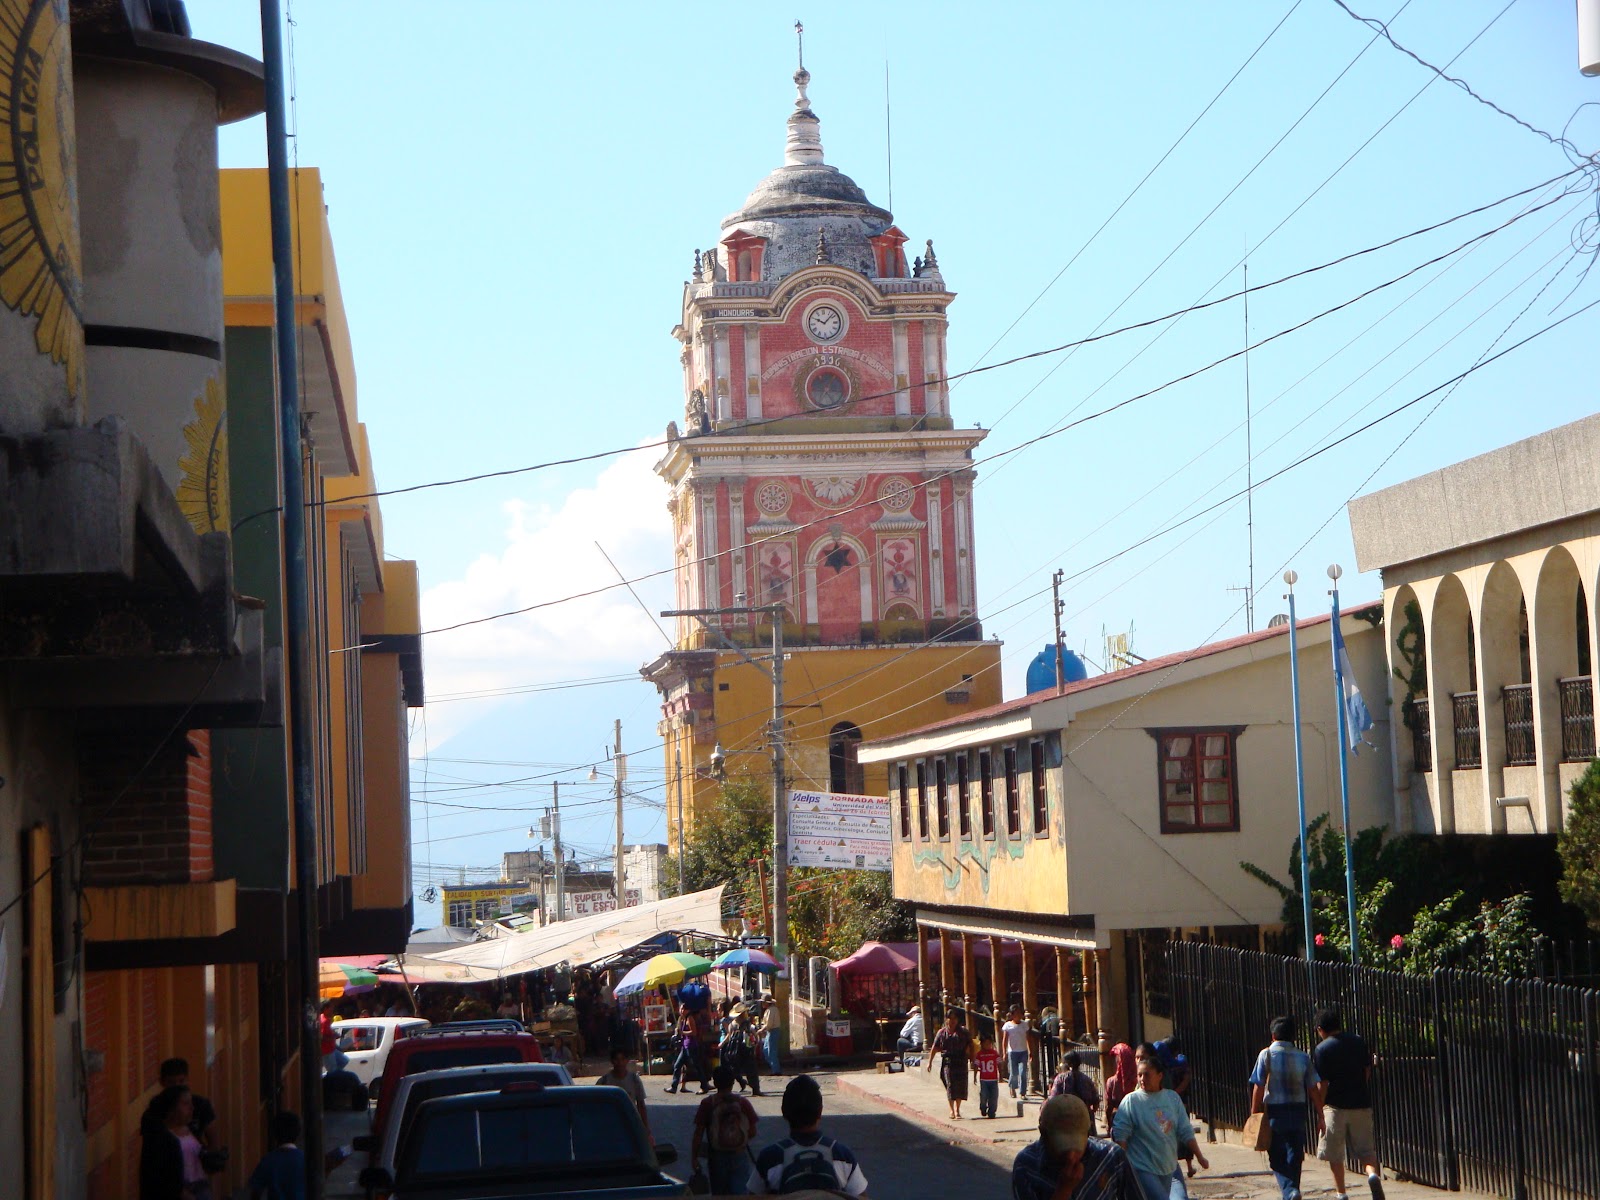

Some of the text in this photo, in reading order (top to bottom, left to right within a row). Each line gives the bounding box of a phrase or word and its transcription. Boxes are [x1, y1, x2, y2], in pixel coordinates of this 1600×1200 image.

[20, 46, 45, 191] POLICIA
[719, 309, 755, 317] HONDURAS
[822, 345, 859, 358] ESTRADA
[860, 353, 894, 381] CABRERA
[210, 449, 220, 520] POLICIA
[829, 795, 874, 804] JORNADA
[813, 838, 837, 846] cédula
[574, 893, 603, 903] SUPER
[981, 1060, 995, 1073] 16
